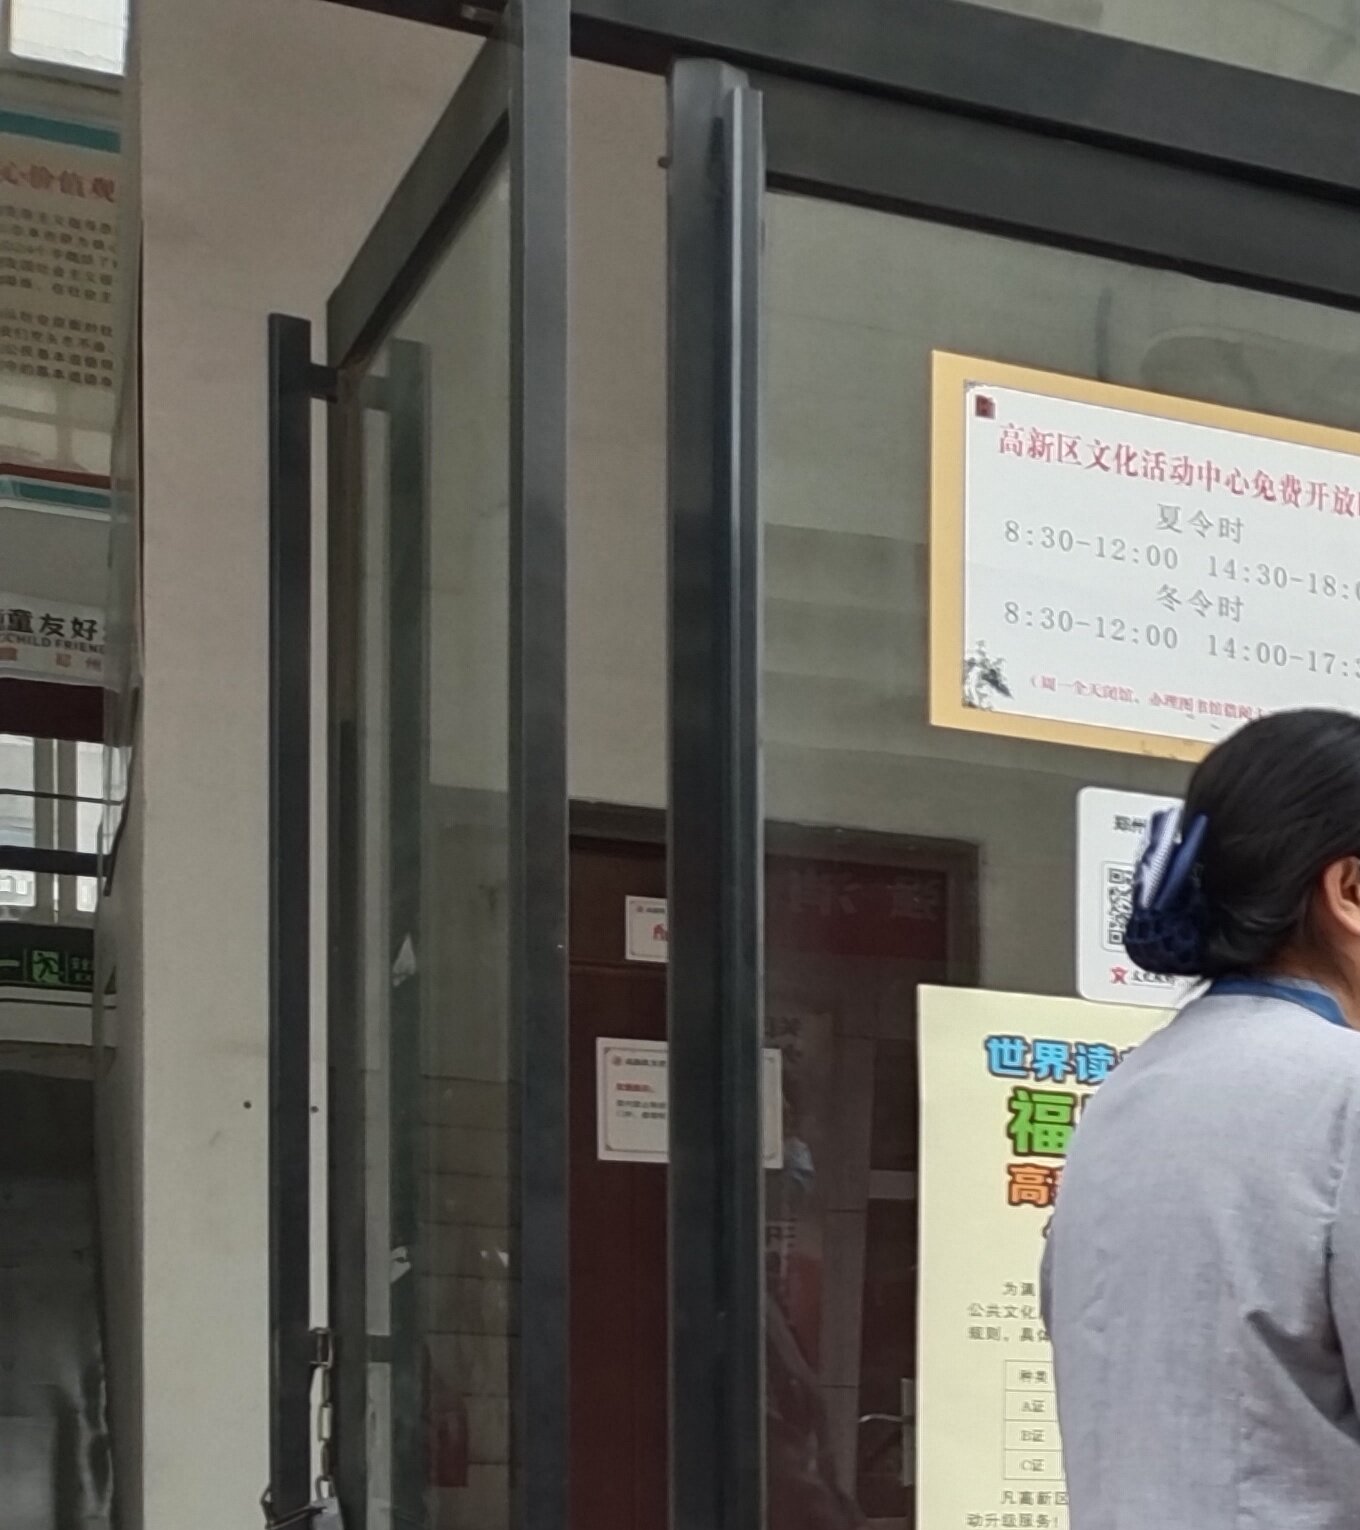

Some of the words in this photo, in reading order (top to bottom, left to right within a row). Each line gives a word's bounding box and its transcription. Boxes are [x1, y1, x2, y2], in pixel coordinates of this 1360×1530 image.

[1004, 519, 1179, 570] 8:30-12:00
[1155, 503, 1245, 544] 夏令时
[1004, 601, 1179, 650] 8:30-12:00
[1156, 584, 1245, 624] 冬令时
[984, 1035, 1132, 1086] 世界读
[1006, 1086, 1090, 1158] 福
